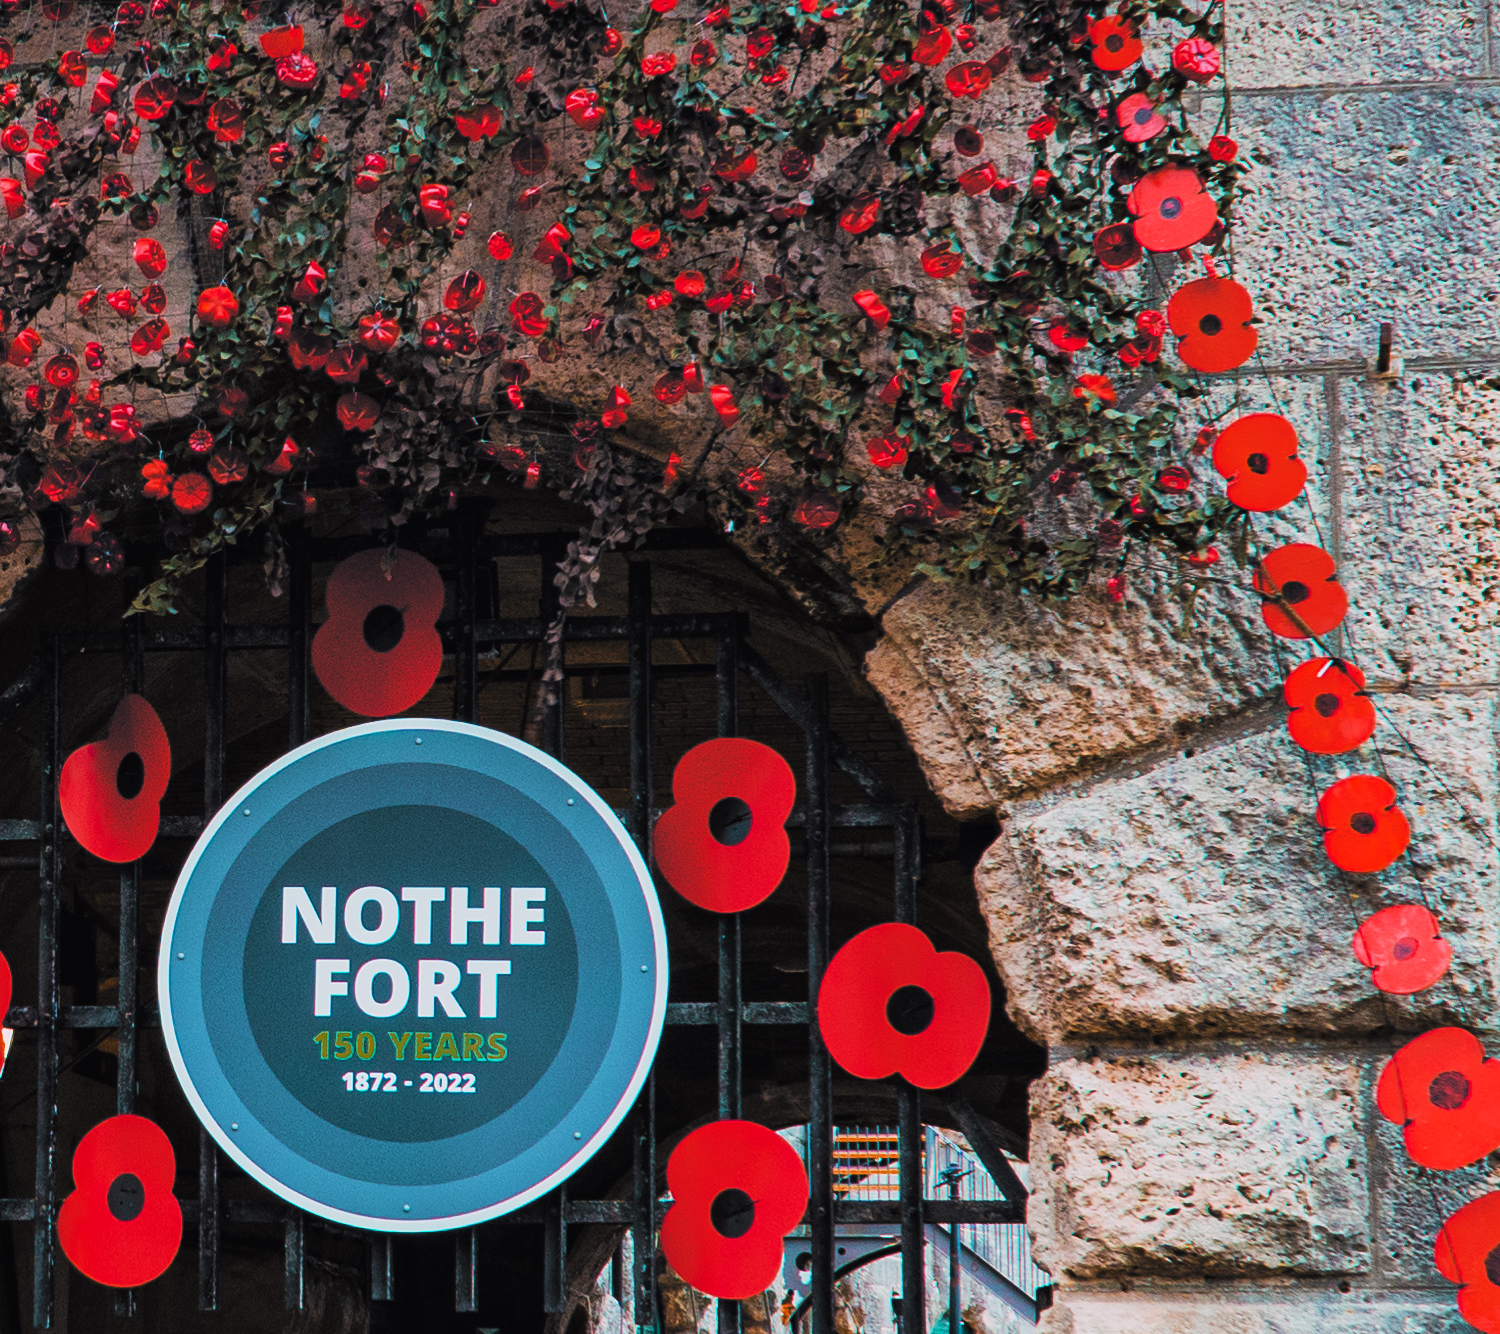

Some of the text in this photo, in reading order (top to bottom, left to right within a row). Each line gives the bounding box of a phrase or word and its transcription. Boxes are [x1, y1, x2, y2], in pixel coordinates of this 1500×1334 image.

[281, 885, 547, 945] NOTHE
[314, 958, 511, 1018] FORT
[313, 1031, 508, 1062] 150 YEARS
[342, 1071, 398, 1092] 1872
[419, 1072, 476, 1093] 2022
